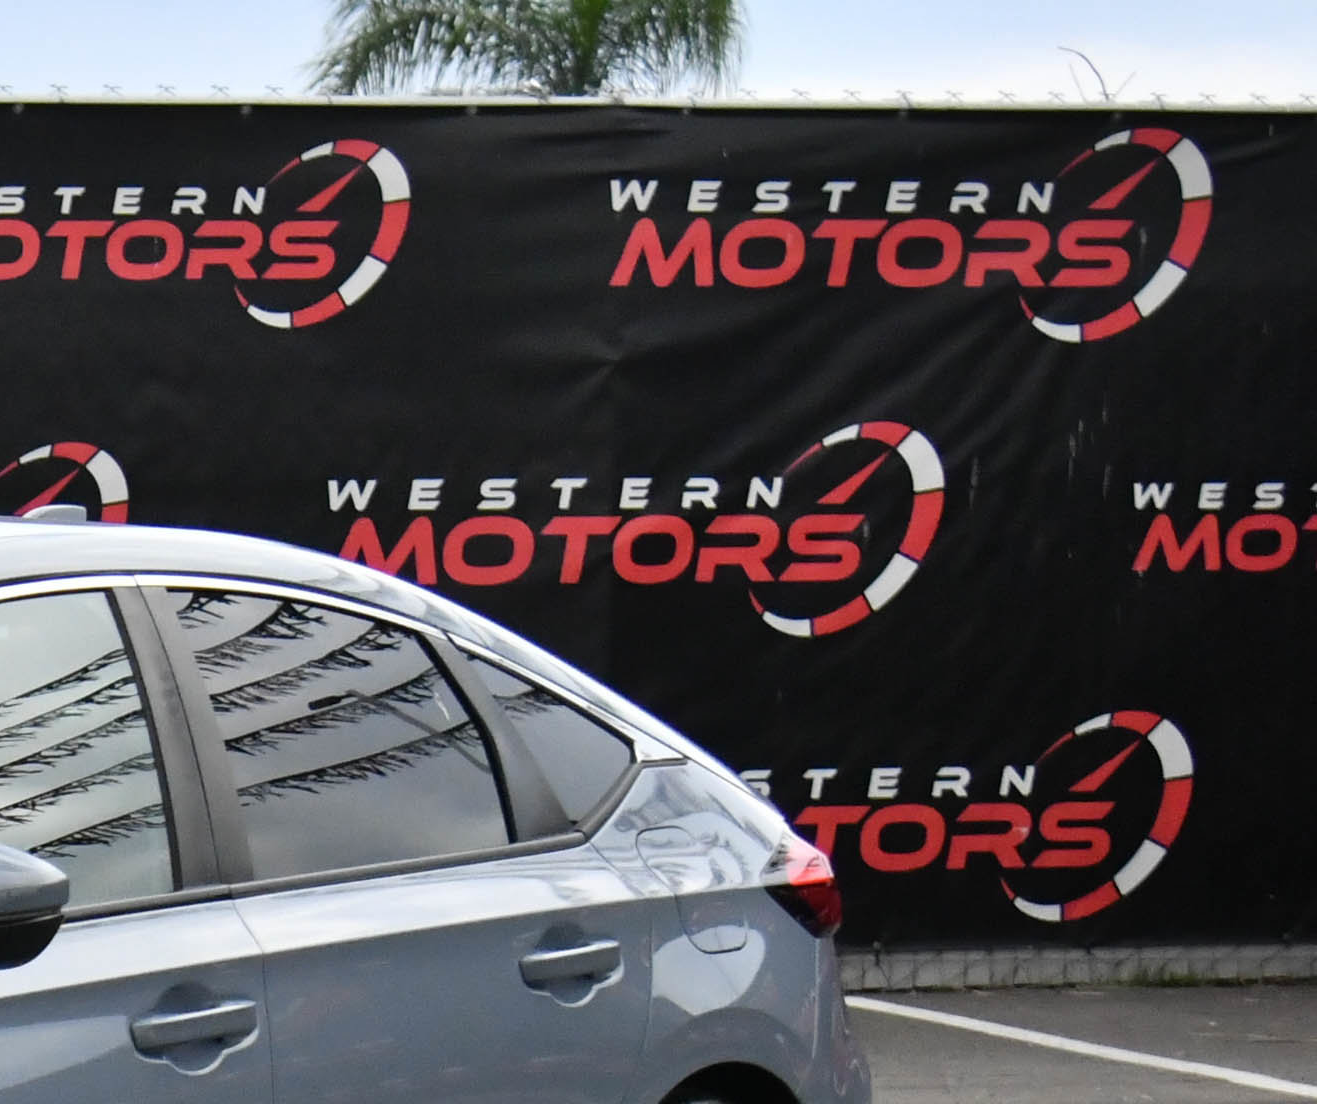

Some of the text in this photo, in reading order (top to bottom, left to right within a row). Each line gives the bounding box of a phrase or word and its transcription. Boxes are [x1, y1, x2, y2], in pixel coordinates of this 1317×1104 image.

[610, 178, 1054, 213] WESTERN
[610, 217, 1133, 289] MOTORS
[327, 476, 783, 512] WESTERN
[1133, 481, 1317, 511] WES
[338, 513, 866, 588] MOTORS
[1131, 512, 1317, 573] MO
